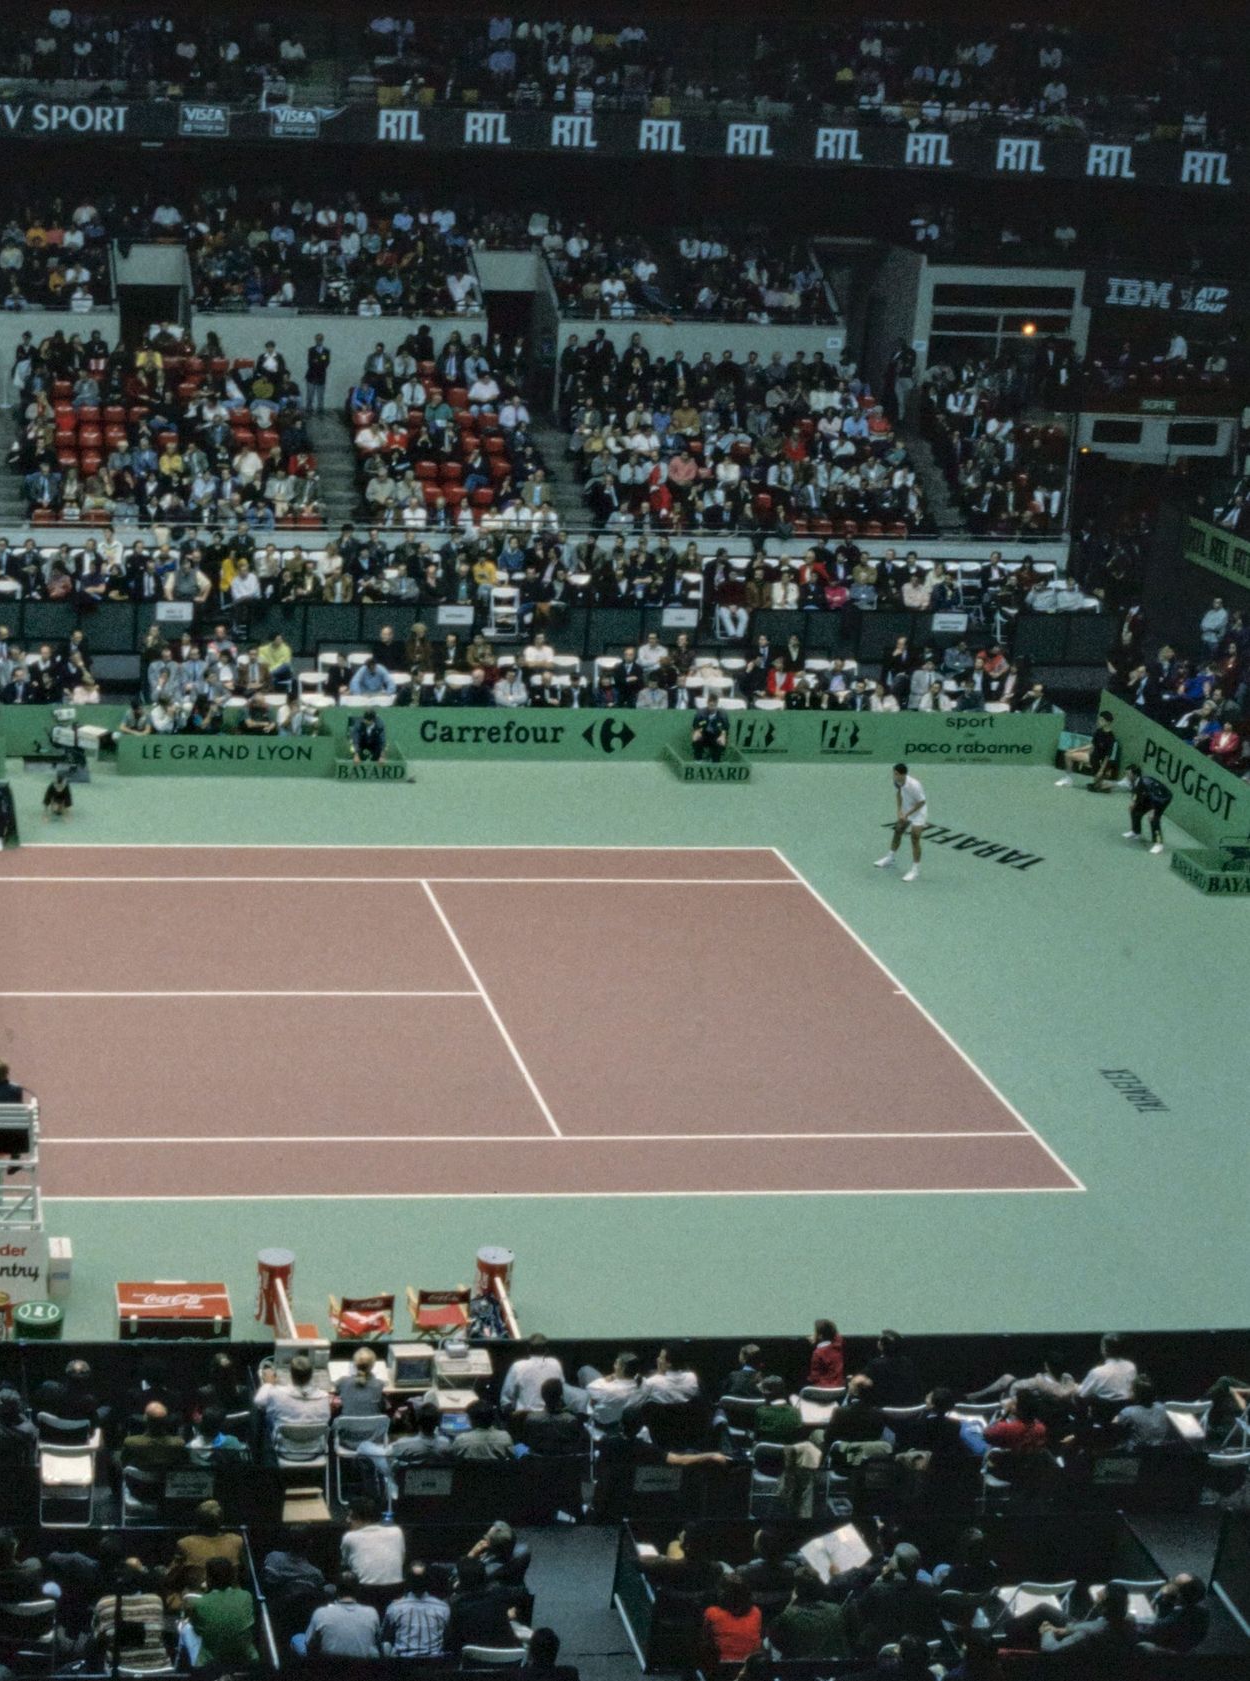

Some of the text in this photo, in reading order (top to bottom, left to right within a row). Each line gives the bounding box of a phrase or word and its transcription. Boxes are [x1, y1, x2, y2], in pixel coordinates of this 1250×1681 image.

[32, 103, 128, 131] SPORT
[378, 108, 425, 141] RTL
[465, 112, 511, 144] RTL
[551, 114, 598, 147] RTL
[639, 119, 685, 152] RTL
[726, 123, 773, 156] RTL
[816, 128, 863, 160] RTL
[905, 132, 953, 166] RTL
[996, 138, 1045, 172] RTL
[1086, 143, 1136, 178] RTL
[1181, 150, 1231, 185] RTL
[1105, 277, 1173, 309] IBM
[1196, 286, 1230, 301] ATP
[419, 720, 566, 744] Carrefour
[945, 715, 995, 730] sport
[142, 743, 313, 761] LE GRAND LYON
[905, 741, 1033, 755] paco rabanne
[337, 763, 406, 780] BAYARD
[682, 766, 750, 781] BAYARD
[1142, 738, 1238, 821] PEUGEOT
